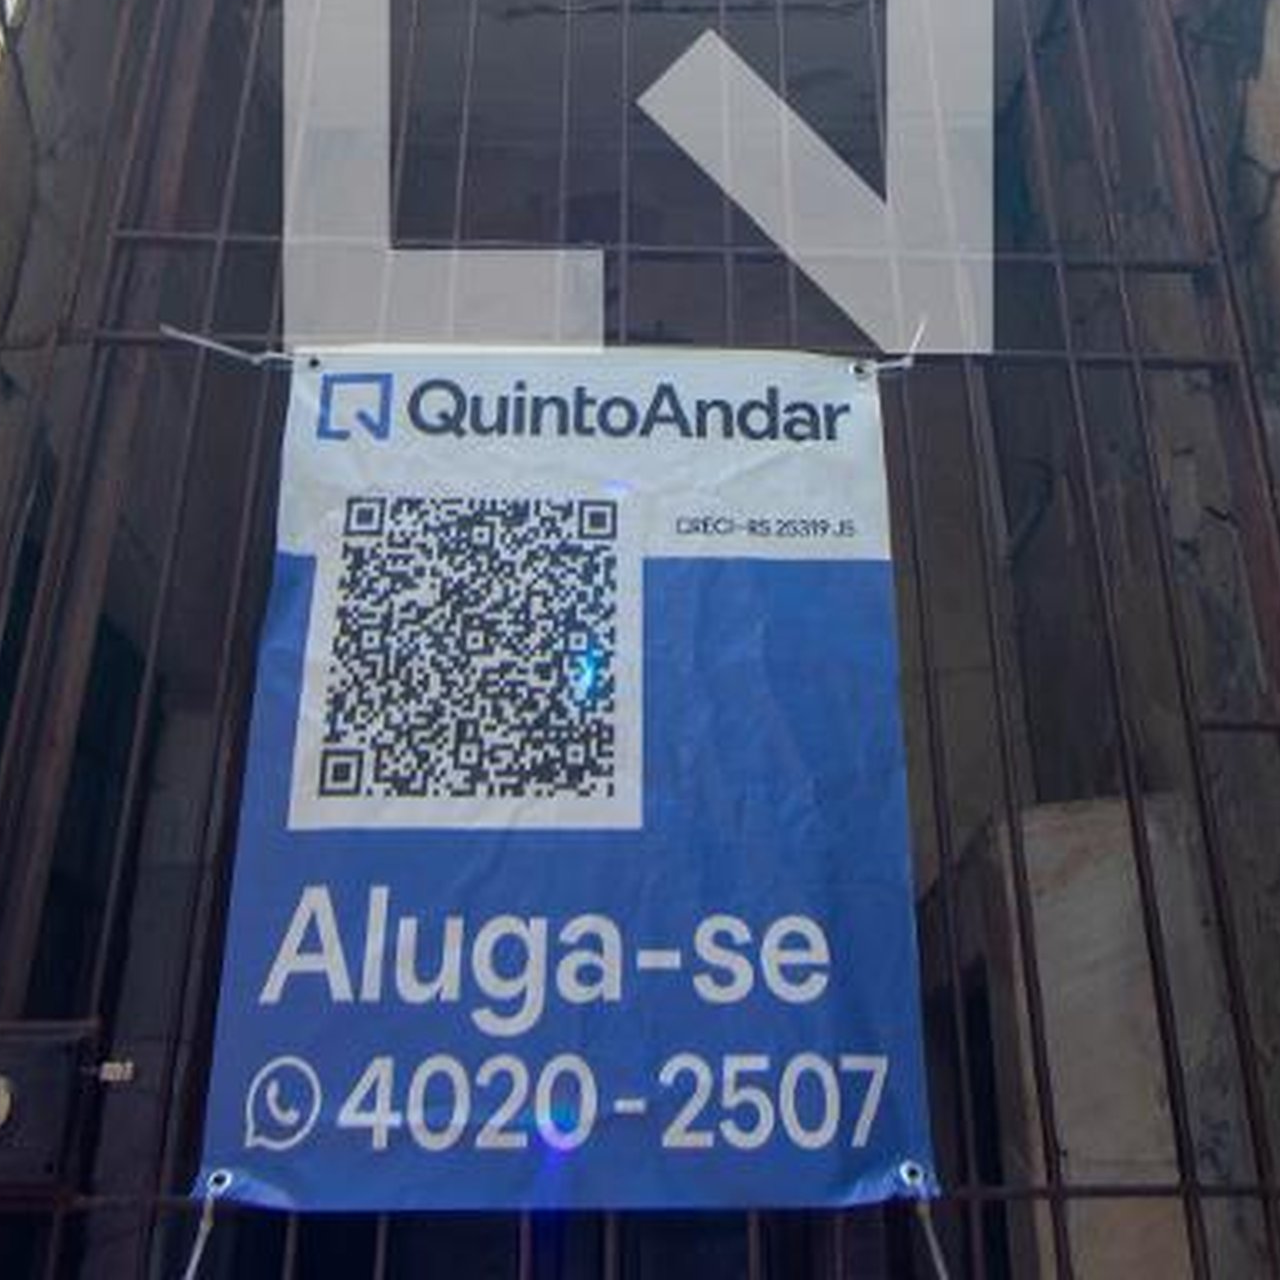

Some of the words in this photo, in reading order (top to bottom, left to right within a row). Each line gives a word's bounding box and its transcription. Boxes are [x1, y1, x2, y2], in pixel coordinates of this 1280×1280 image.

[407, 378, 851, 443] QuintoAndar
[259, 885, 830, 1036] Aluga-se
[337, 1053, 888, 1151] 4020-2507
